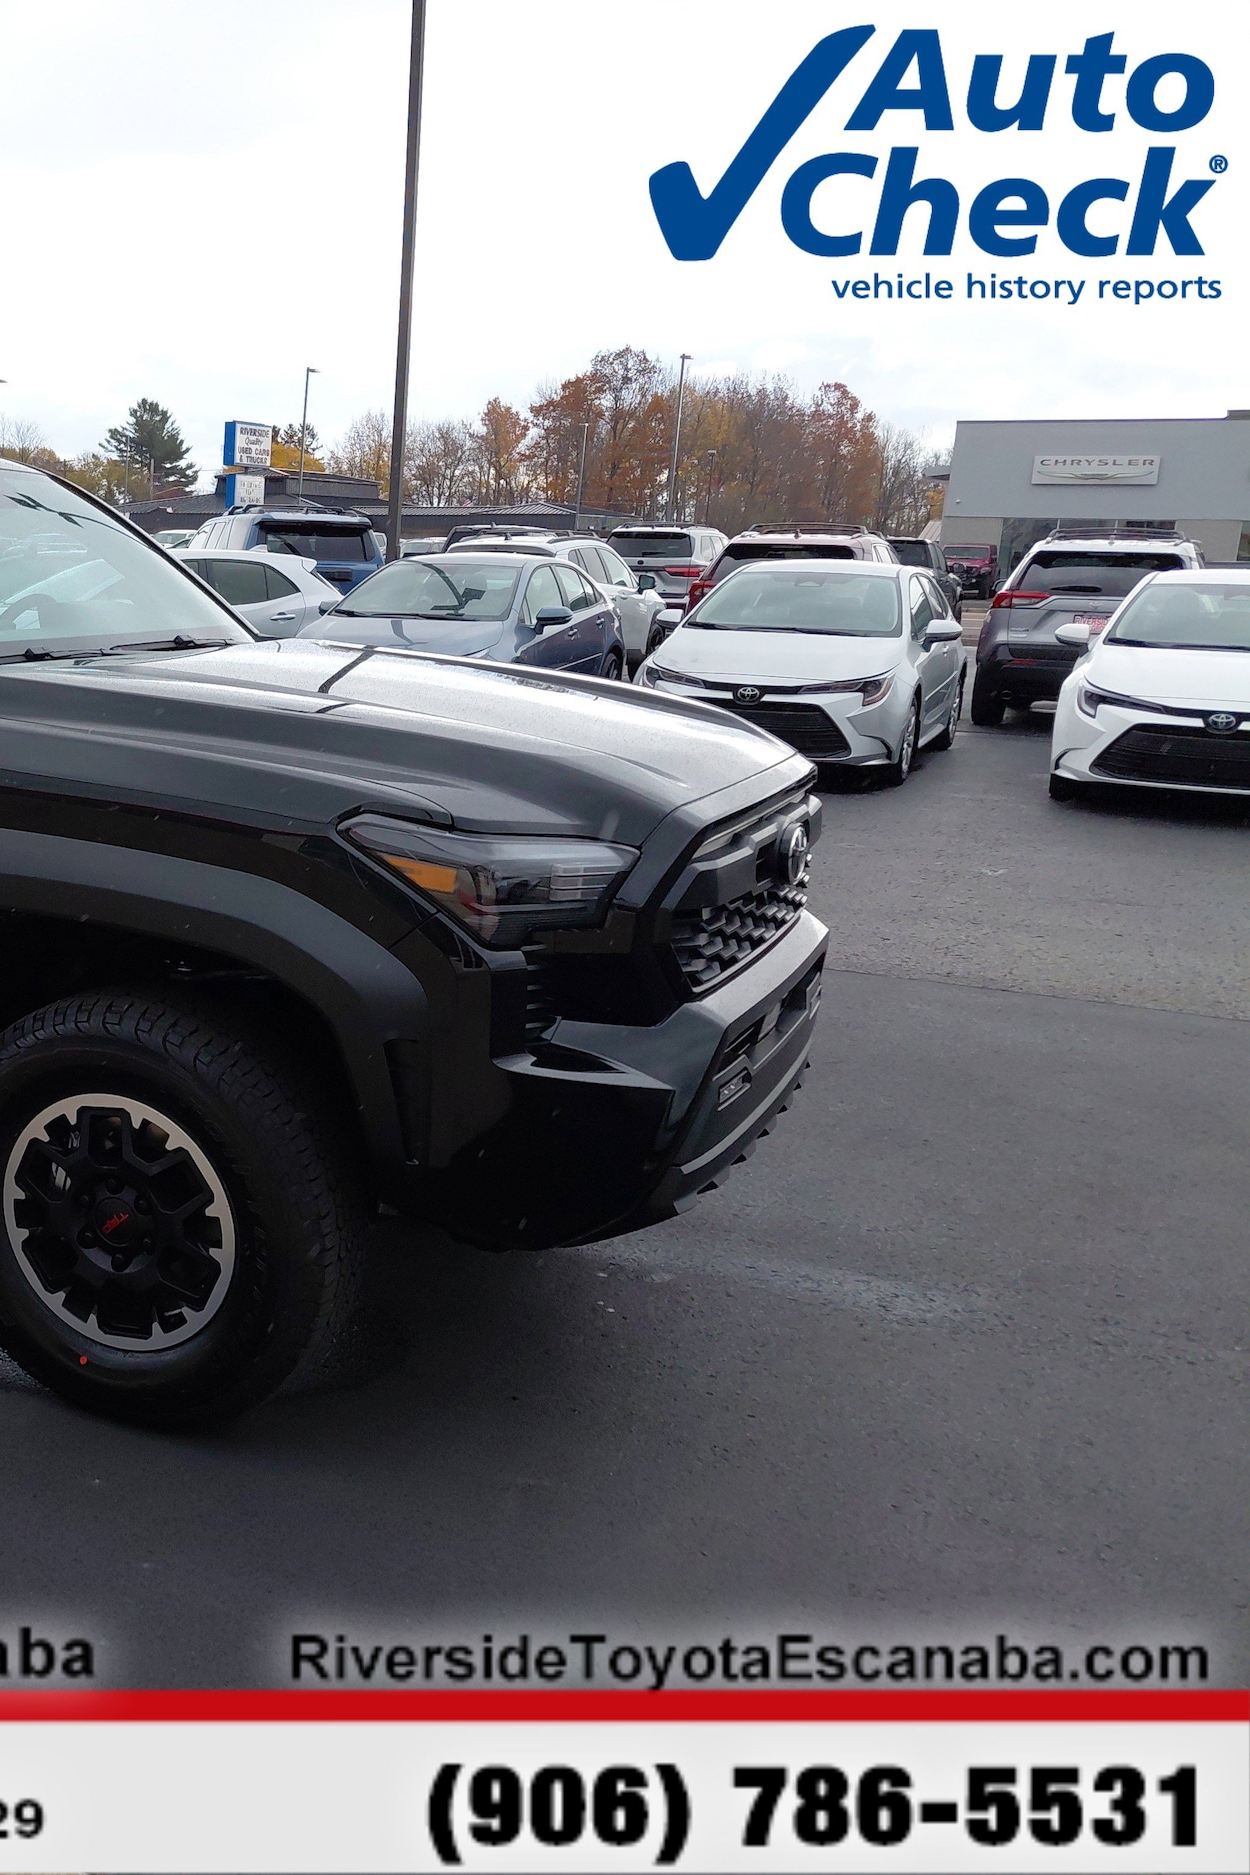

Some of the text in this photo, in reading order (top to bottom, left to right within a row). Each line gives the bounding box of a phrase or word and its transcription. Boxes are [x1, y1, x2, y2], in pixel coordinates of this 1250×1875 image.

[239, 427, 270, 438] RIVERSIDE
[238, 446, 269, 456] USED CARS
[246, 455, 268, 464] TRUCKS
[1039, 457, 1156, 468] CHRYSLER
[1075, 615, 1109, 627] RIVERSID
